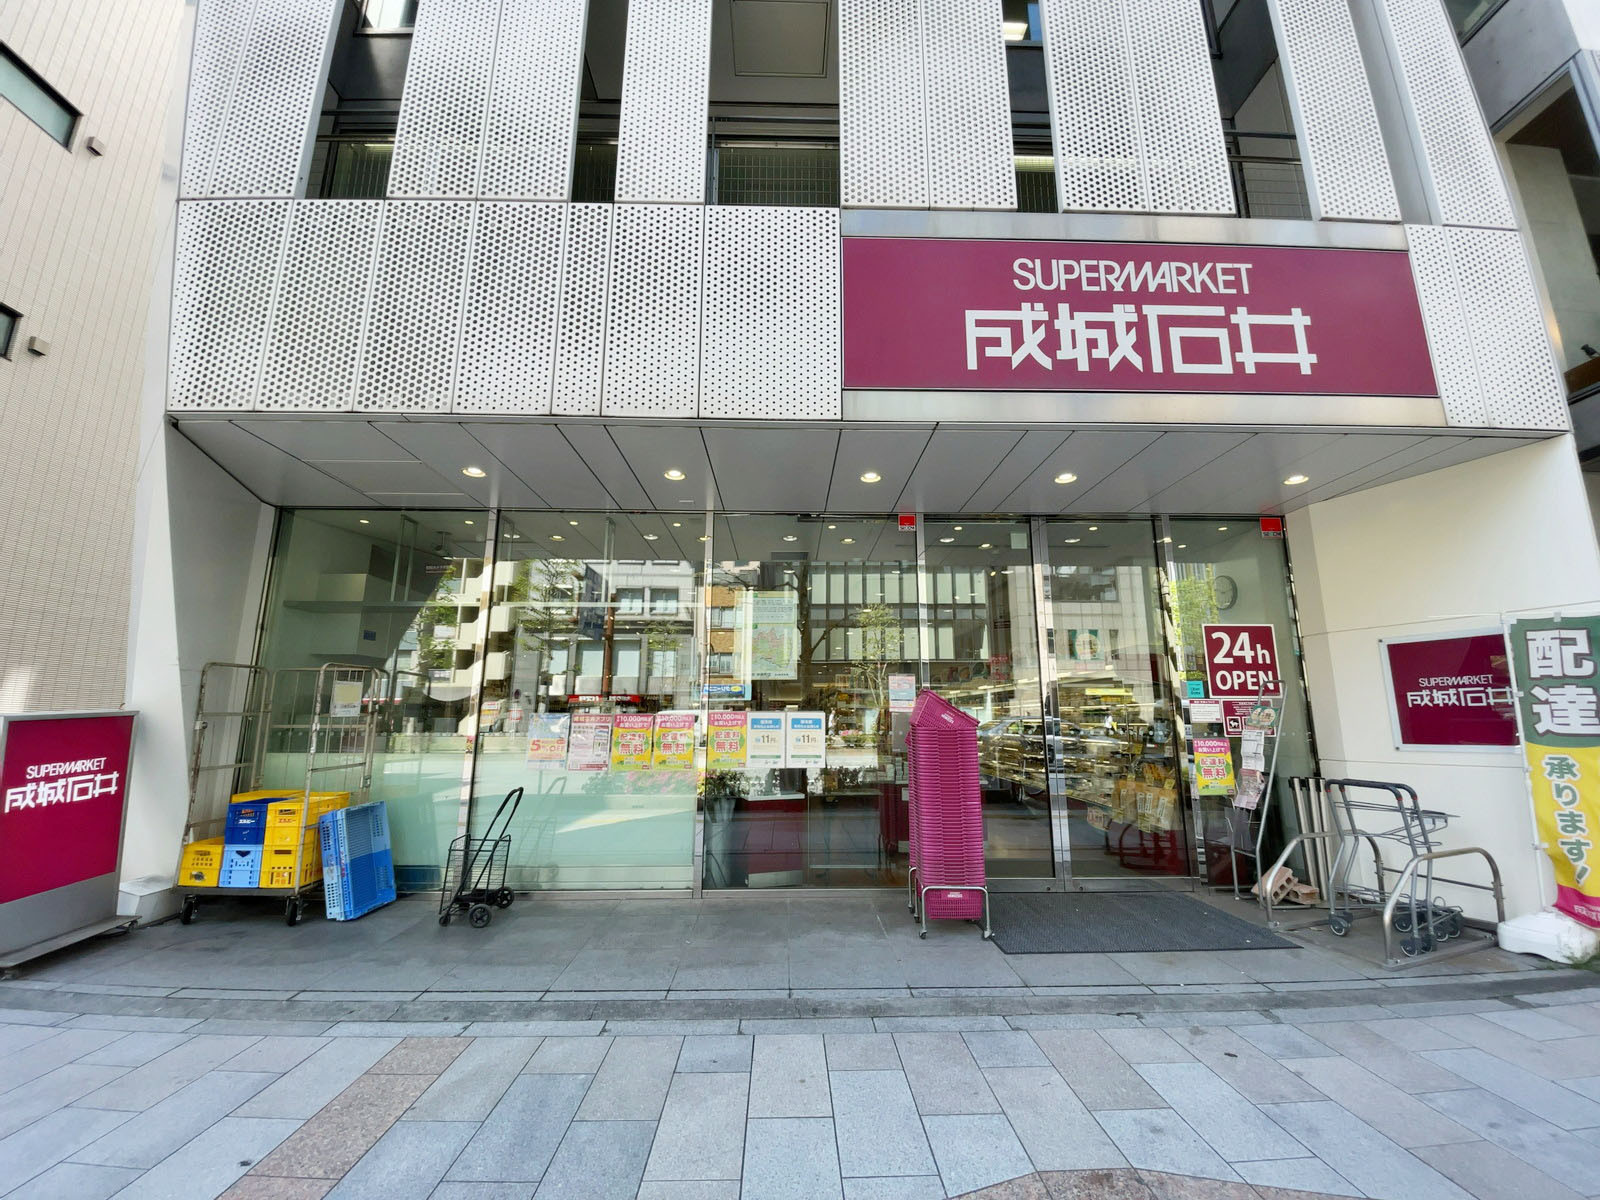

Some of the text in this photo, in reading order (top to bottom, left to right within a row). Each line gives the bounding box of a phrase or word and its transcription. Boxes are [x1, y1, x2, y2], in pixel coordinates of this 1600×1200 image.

[1012, 257, 1253, 295] SUPERMARKET
[964, 301, 1318, 375] 成城石井
[1211, 631, 1271, 664] 24h
[1215, 670, 1275, 690] OPEN
[1418, 674, 1493, 687] SUPERMARKET
[1526, 628, 1600, 734] 配達
[1406, 686, 1514, 708] 成城石井
[26, 757, 107, 779] SUPERMARKET
[4, 771, 119, 813] 成城石井
